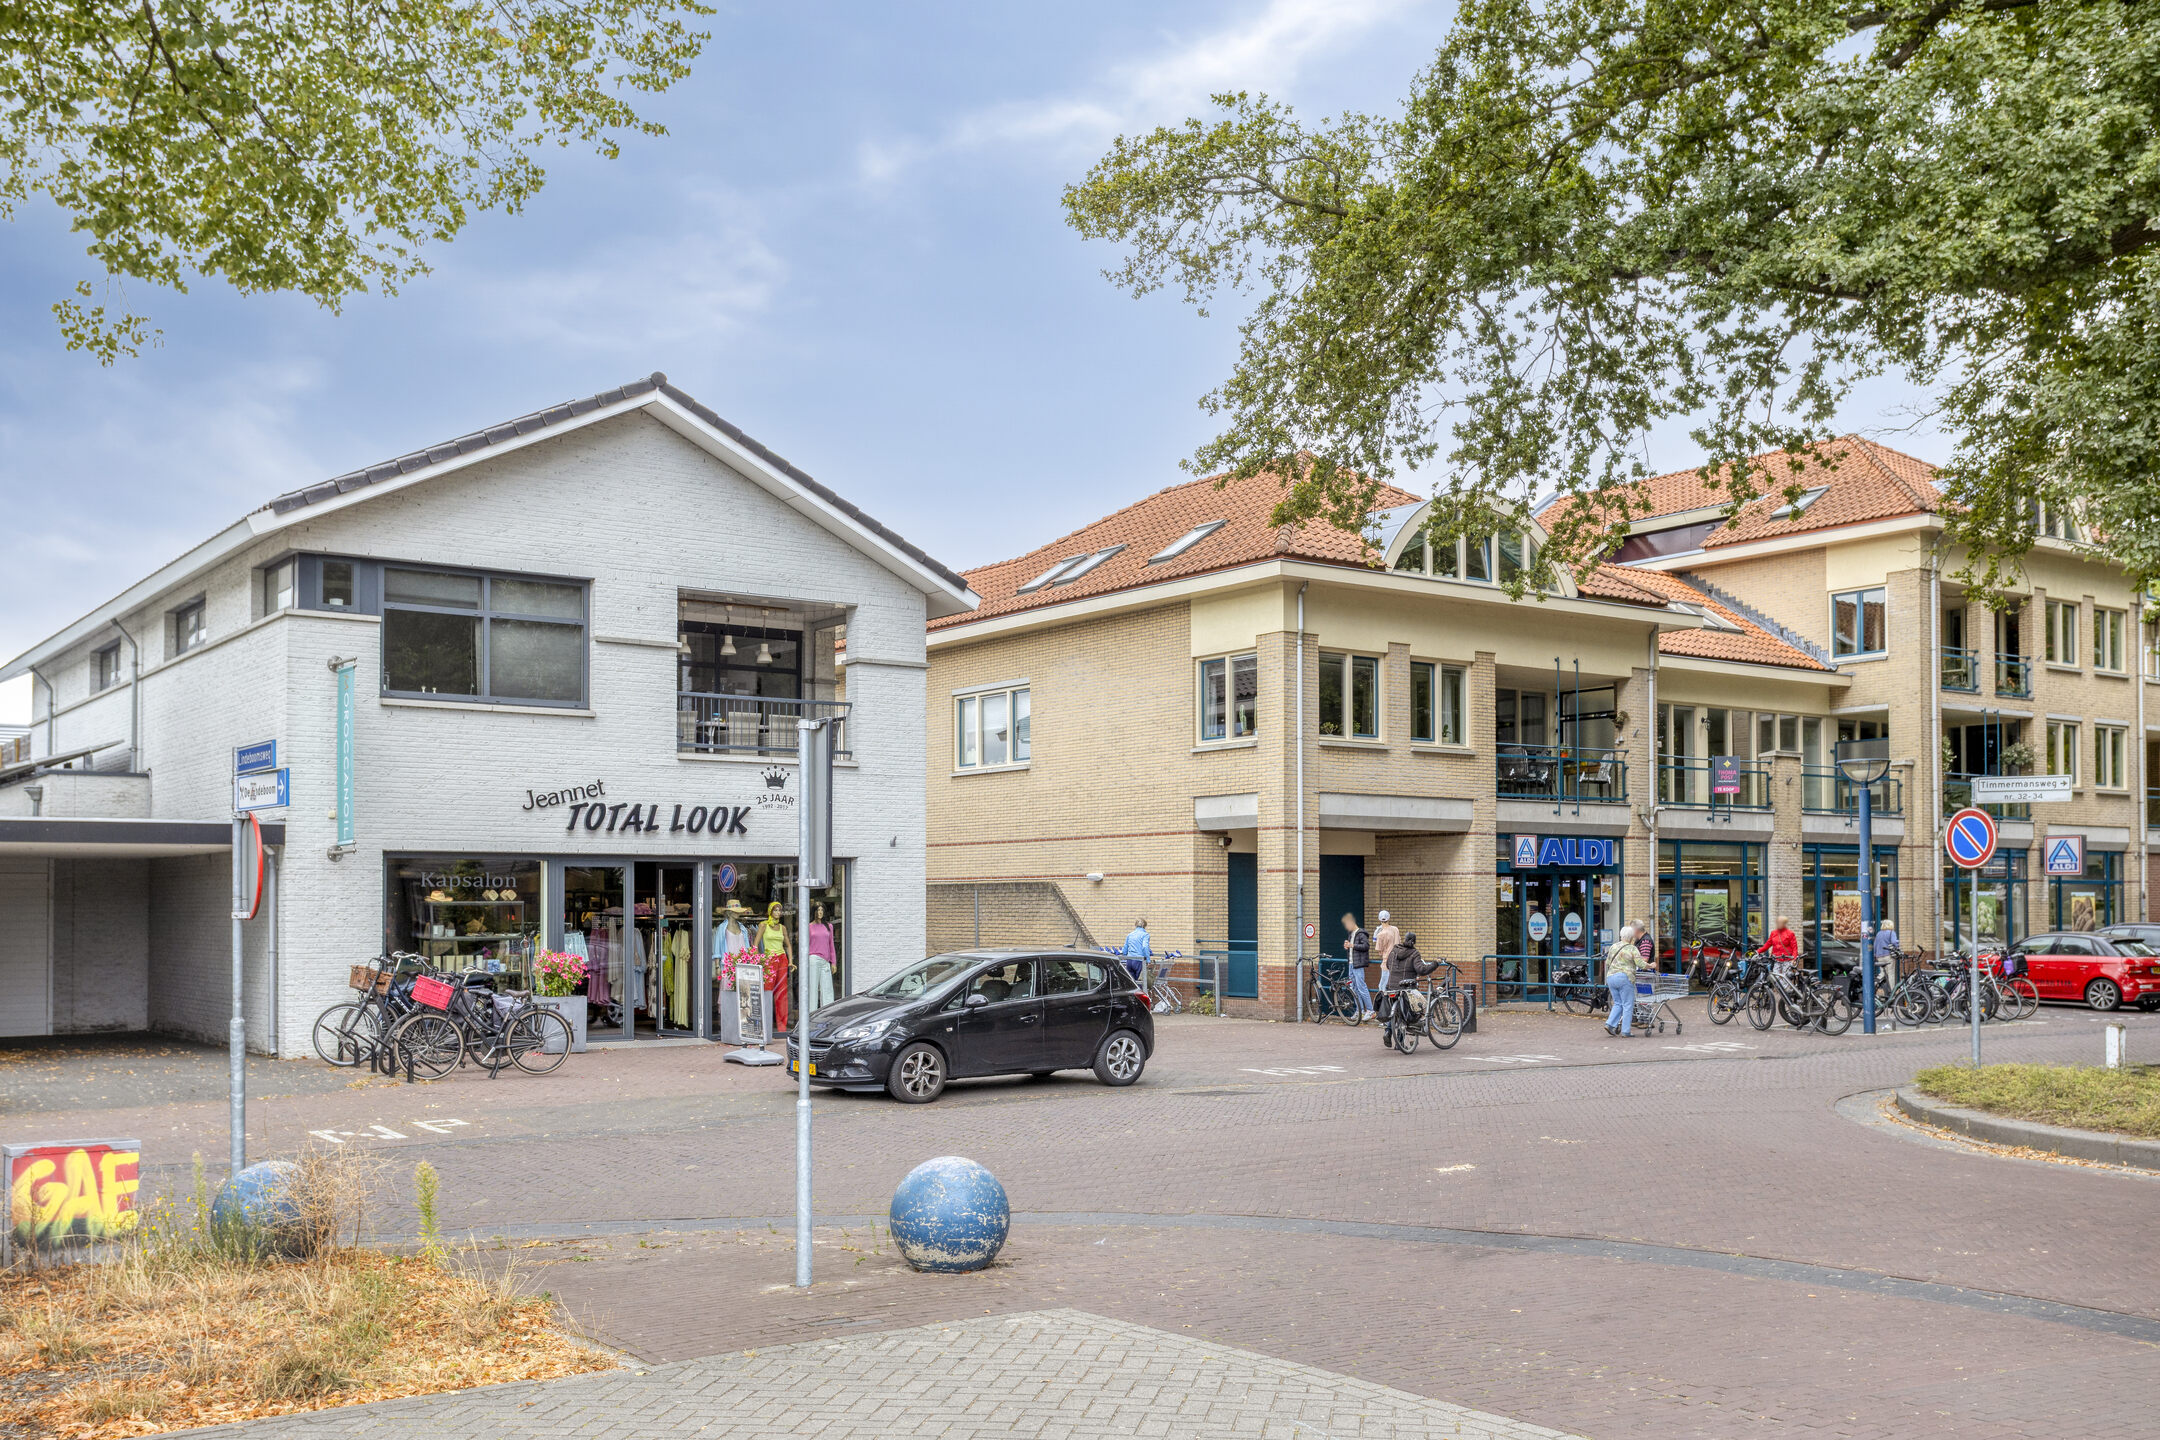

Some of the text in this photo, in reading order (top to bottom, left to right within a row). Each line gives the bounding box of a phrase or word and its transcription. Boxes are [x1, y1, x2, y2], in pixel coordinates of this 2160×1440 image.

[522, 779, 606, 811] Jeannet
[1981, 780, 2057, 789] Timmermansweg
[755, 793, 795, 805] 25 JAAR
[566, 802, 751, 834] TOTAL LOOK
[1538, 838, 1614, 867] ALDI
[421, 871, 517, 892] Kapsalon
